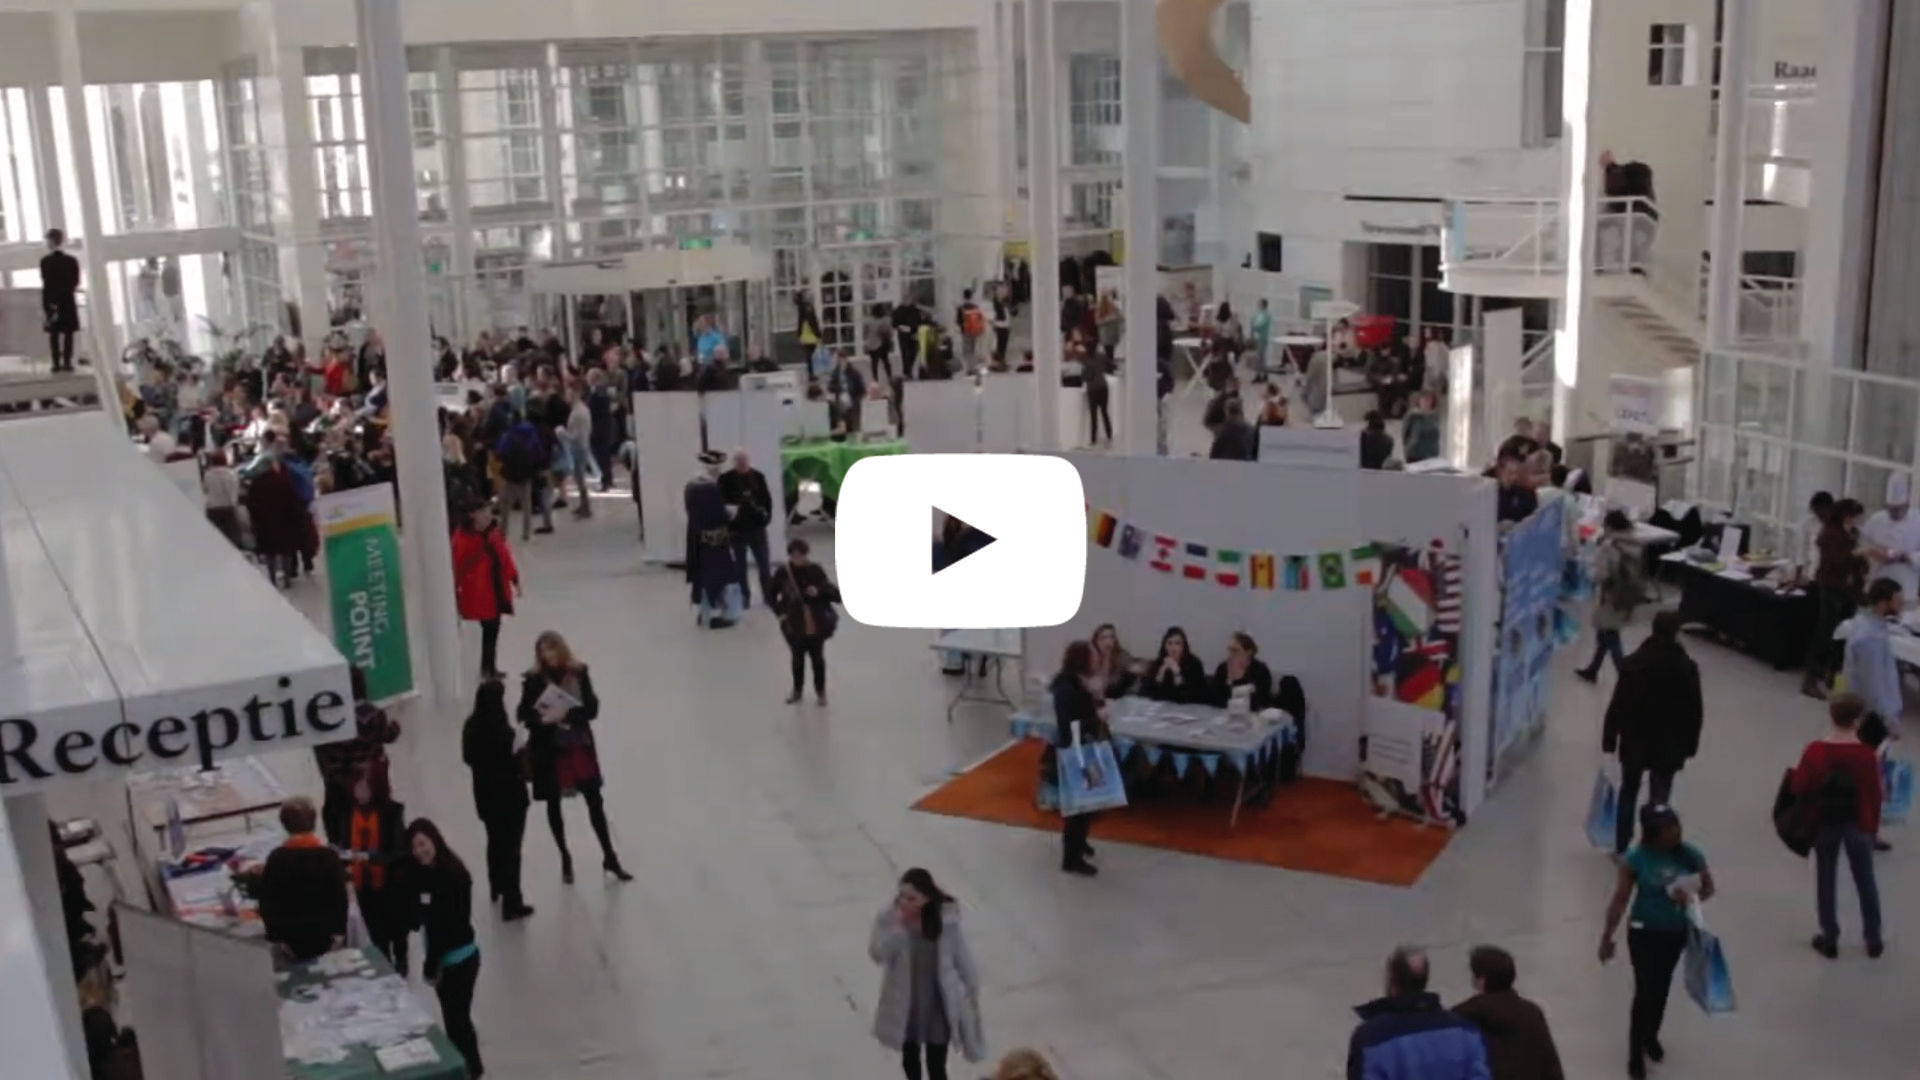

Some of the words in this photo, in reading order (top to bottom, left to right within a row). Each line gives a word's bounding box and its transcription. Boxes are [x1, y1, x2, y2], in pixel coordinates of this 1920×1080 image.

[348, 590, 375, 669] POINT
[366, 537, 390, 634] MEETING
[0, 677, 346, 785] Receptie
